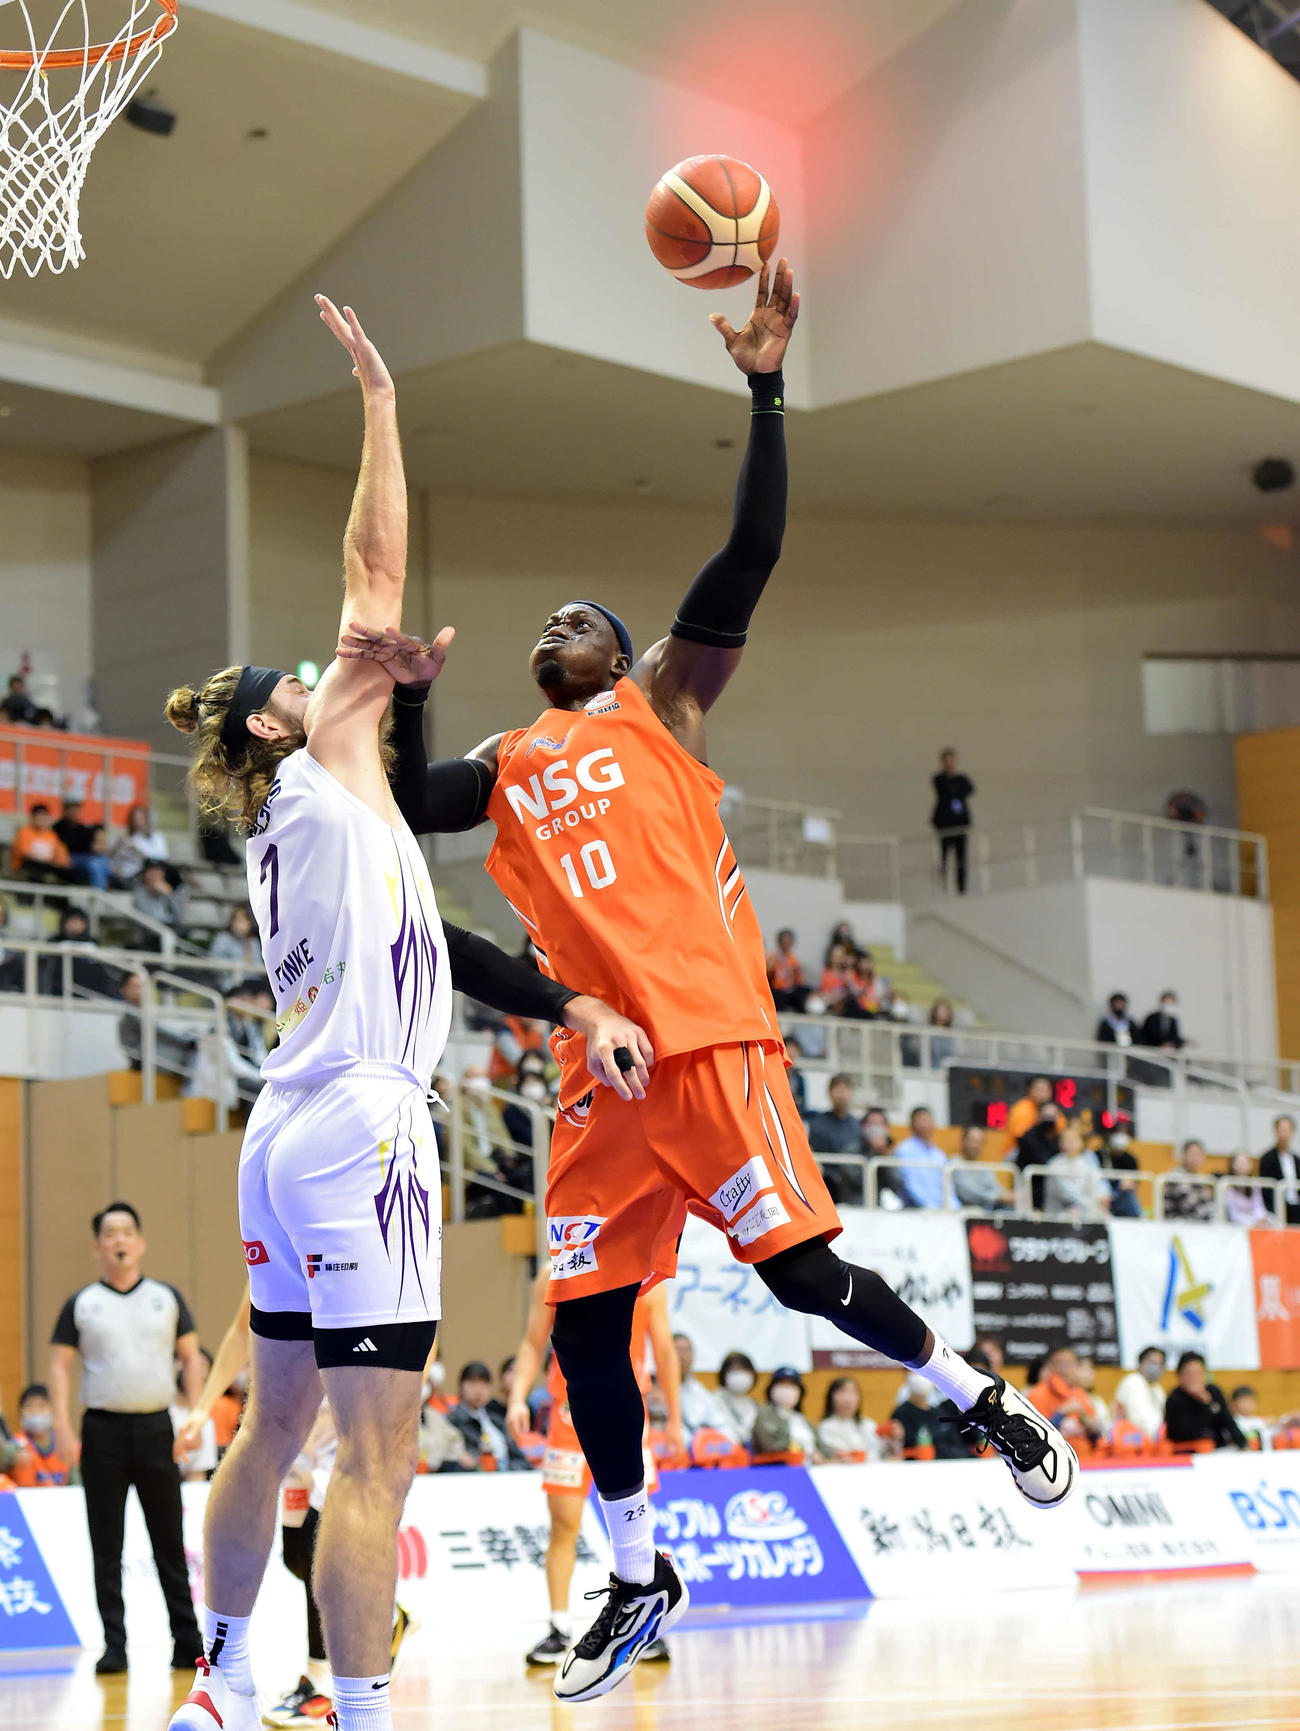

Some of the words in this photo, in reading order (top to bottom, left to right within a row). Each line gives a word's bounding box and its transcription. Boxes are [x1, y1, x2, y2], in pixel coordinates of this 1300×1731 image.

[505, 747, 626, 825] NSG
[535, 798, 611, 841] GROUP
[260, 843, 280, 940] 7
[560, 839, 618, 898] 10
[720, 1173, 752, 1209] Crafty
[624, 1504, 647, 1523] 23
